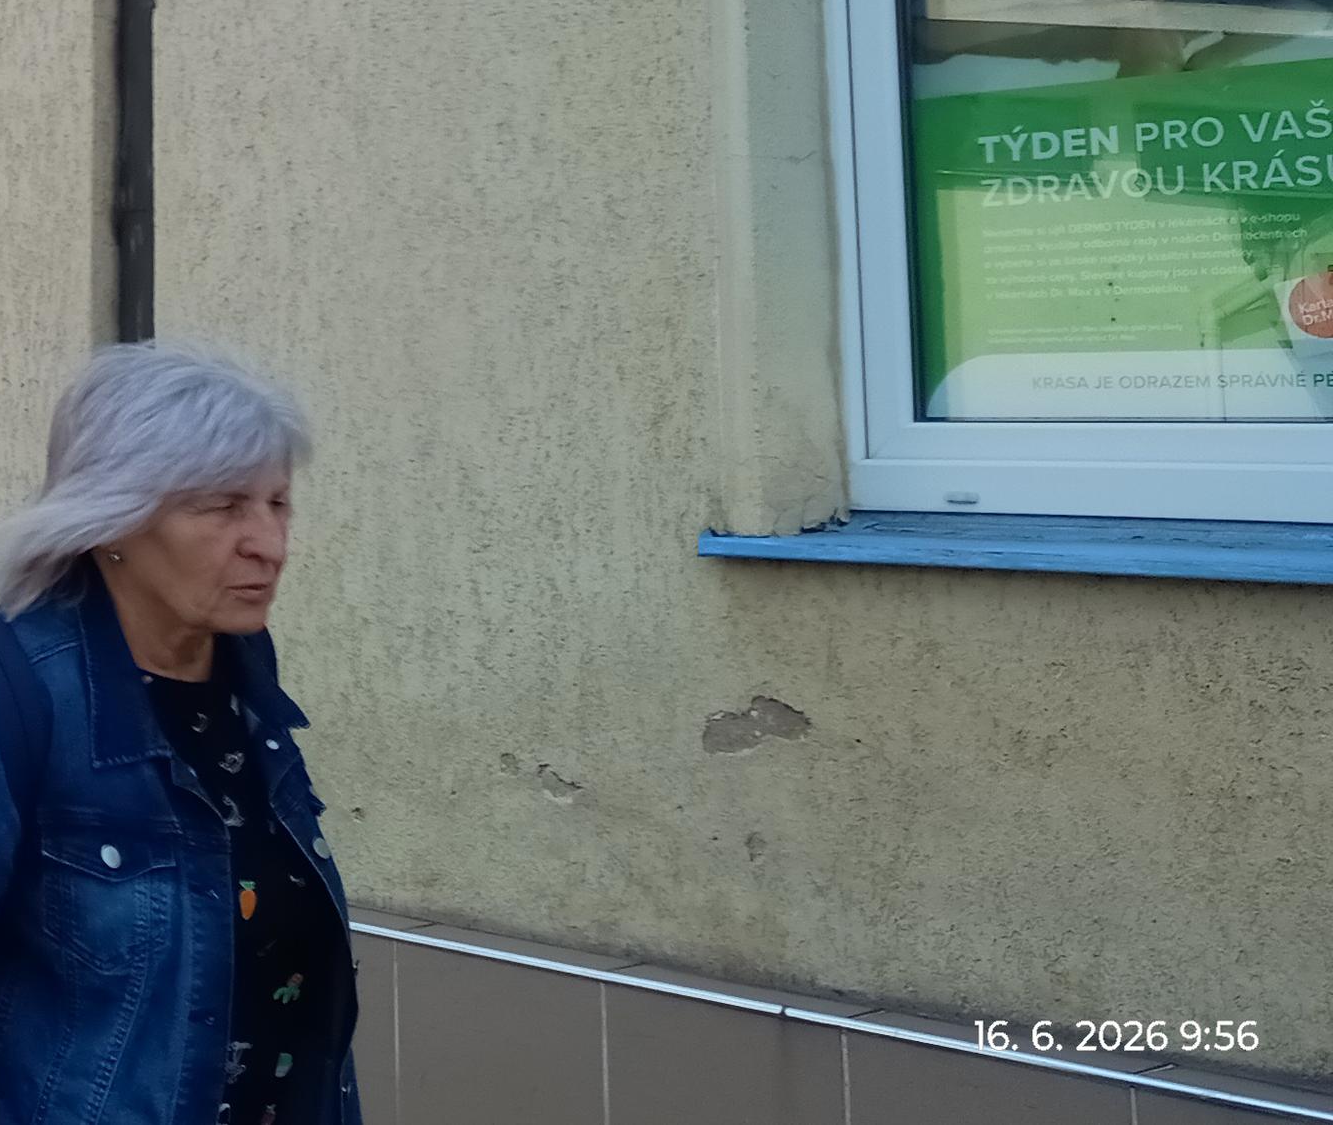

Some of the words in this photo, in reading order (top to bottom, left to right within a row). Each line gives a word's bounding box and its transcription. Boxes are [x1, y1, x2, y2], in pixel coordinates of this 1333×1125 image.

[978, 125, 1120, 164] TÝDEN
[1135, 116, 1224, 153] PRO
[979, 165, 1185, 209] ZDRAVOU
[1202, 149, 1333, 194] KRÁS
[1094, 375, 1114, 389] JE
[1118, 375, 1211, 389] ODRAZEM
